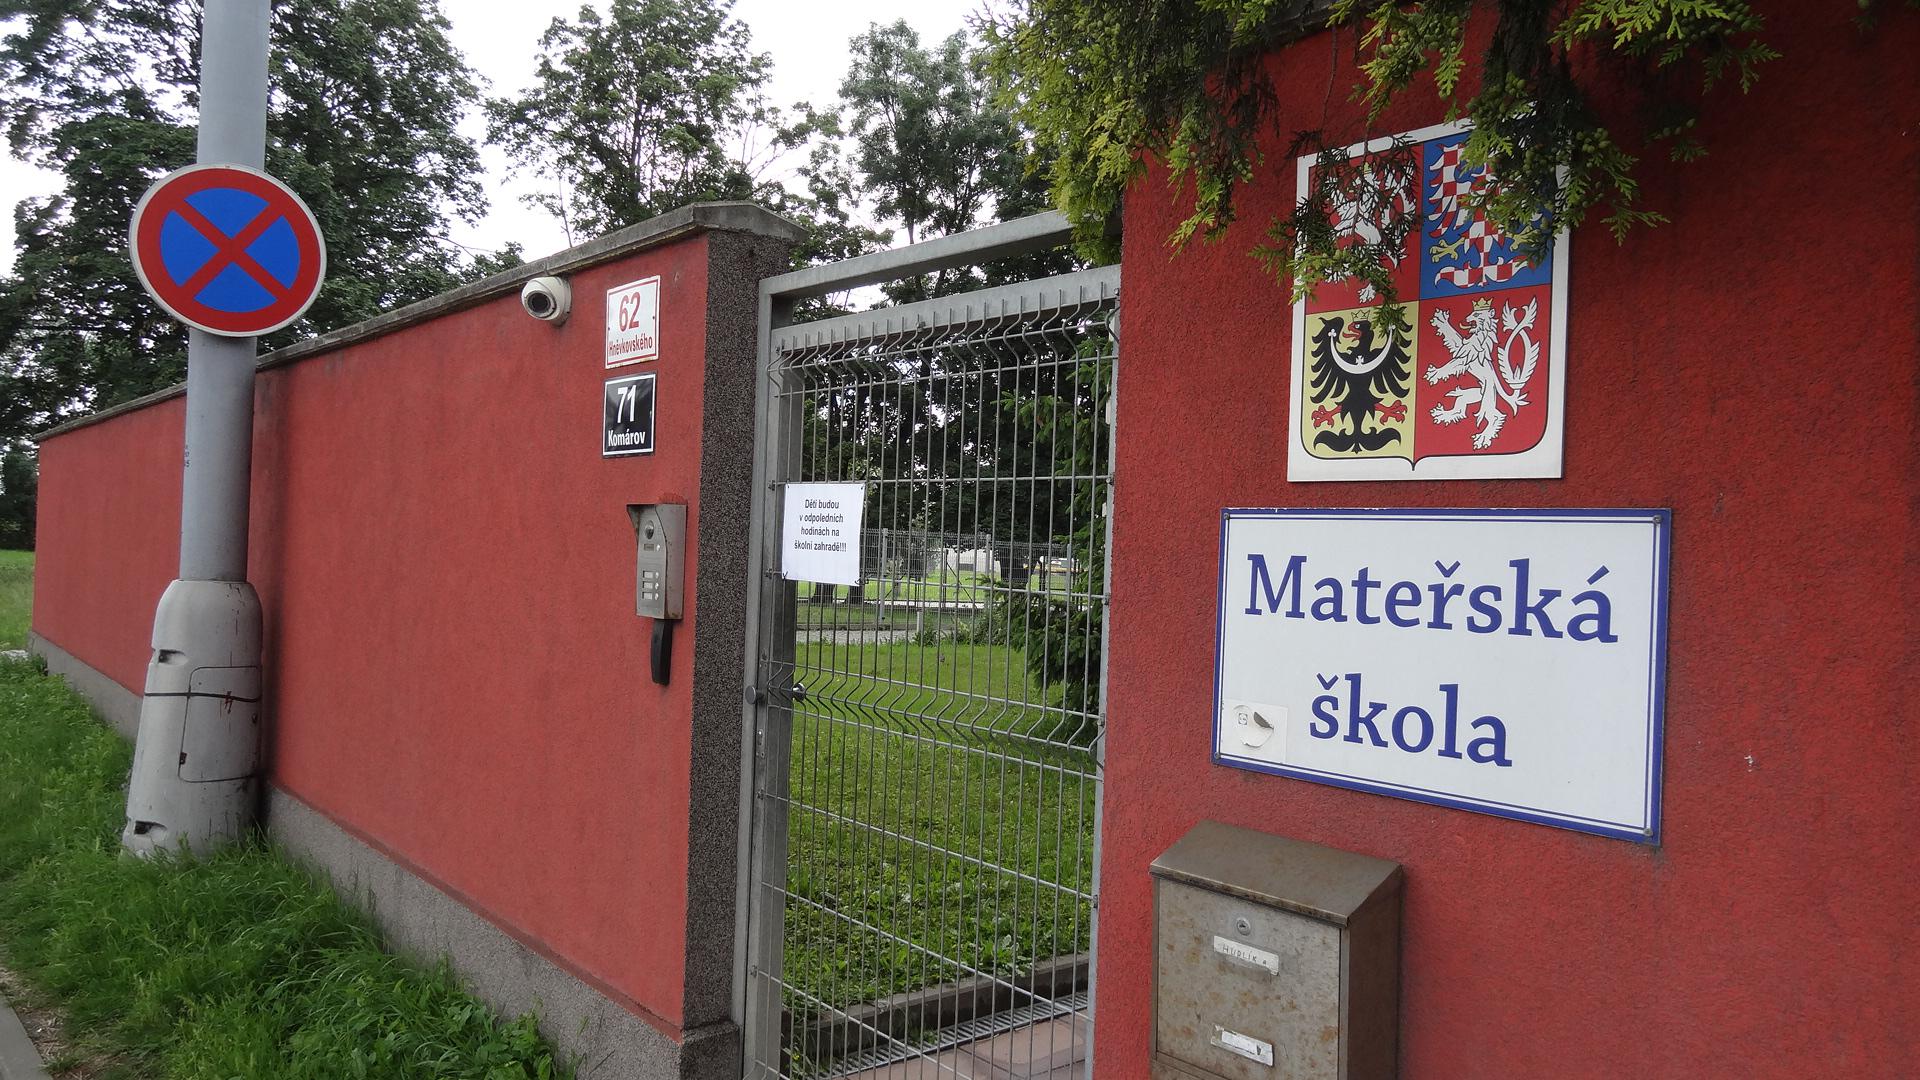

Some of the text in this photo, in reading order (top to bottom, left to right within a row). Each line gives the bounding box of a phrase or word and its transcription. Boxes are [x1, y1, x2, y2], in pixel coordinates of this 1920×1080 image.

[618, 291, 641, 333] 62
[617, 384, 637, 424] 71
[607, 428, 646, 447] Komárov
[804, 499, 840, 509] Děti budou
[804, 513, 844, 524] odpoledních
[800, 526, 840, 537] hodinách na
[794, 539, 847, 552] školní zahradě!!!
[1244, 554, 1618, 643] Mateřská
[1309, 672, 1512, 768] škola
